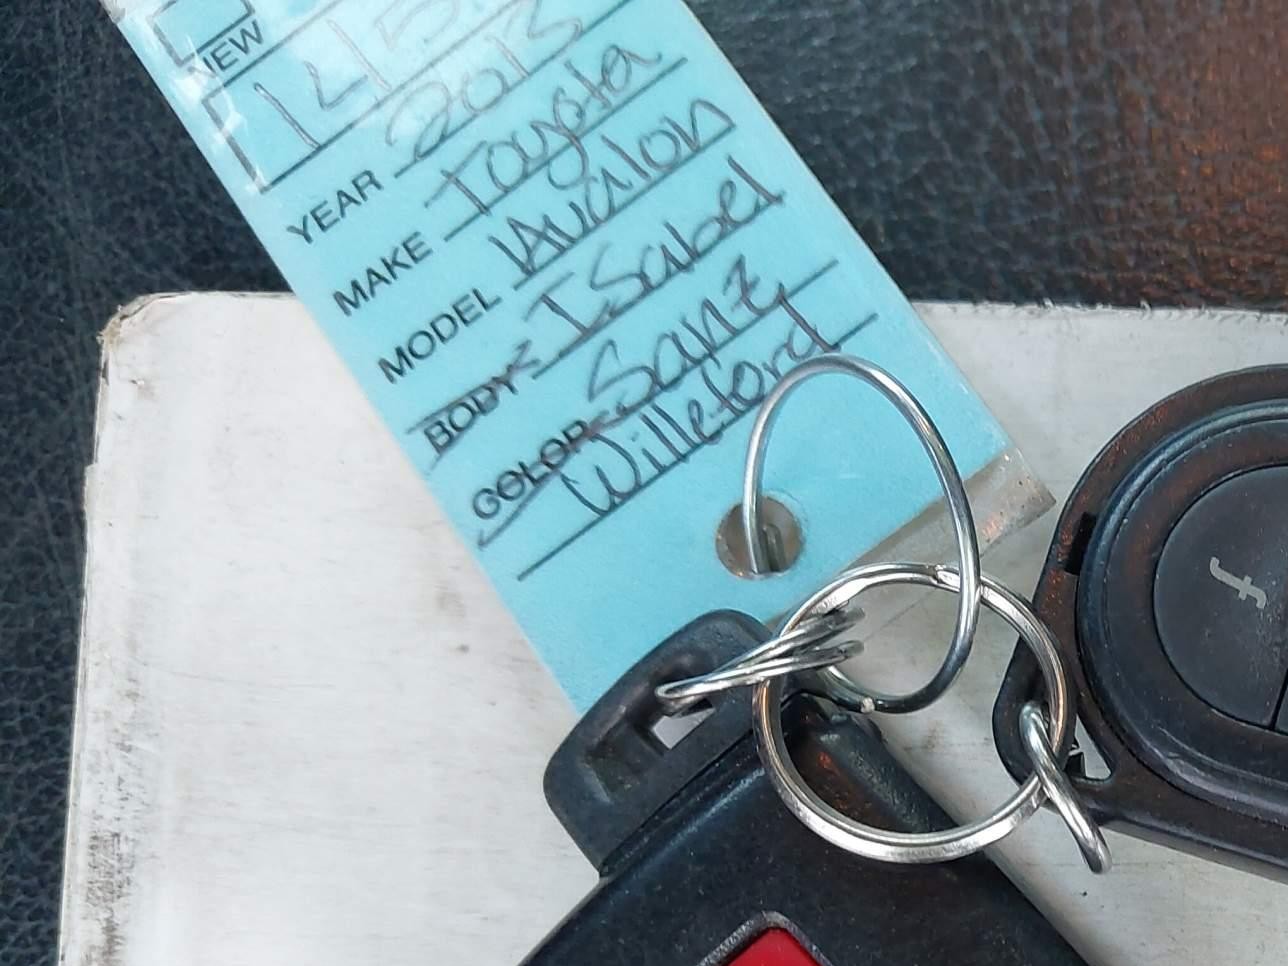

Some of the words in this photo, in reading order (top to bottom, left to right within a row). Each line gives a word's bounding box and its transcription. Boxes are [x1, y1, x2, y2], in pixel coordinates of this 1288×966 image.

[425, 44, 661, 216] Toyota
[287, 169, 384, 245] YEAR
[332, 230, 433, 316] MAKE
[377, 285, 502, 384] MODEL
[424, 359, 521, 456] BODY
[473, 419, 592, 520] COLOR
